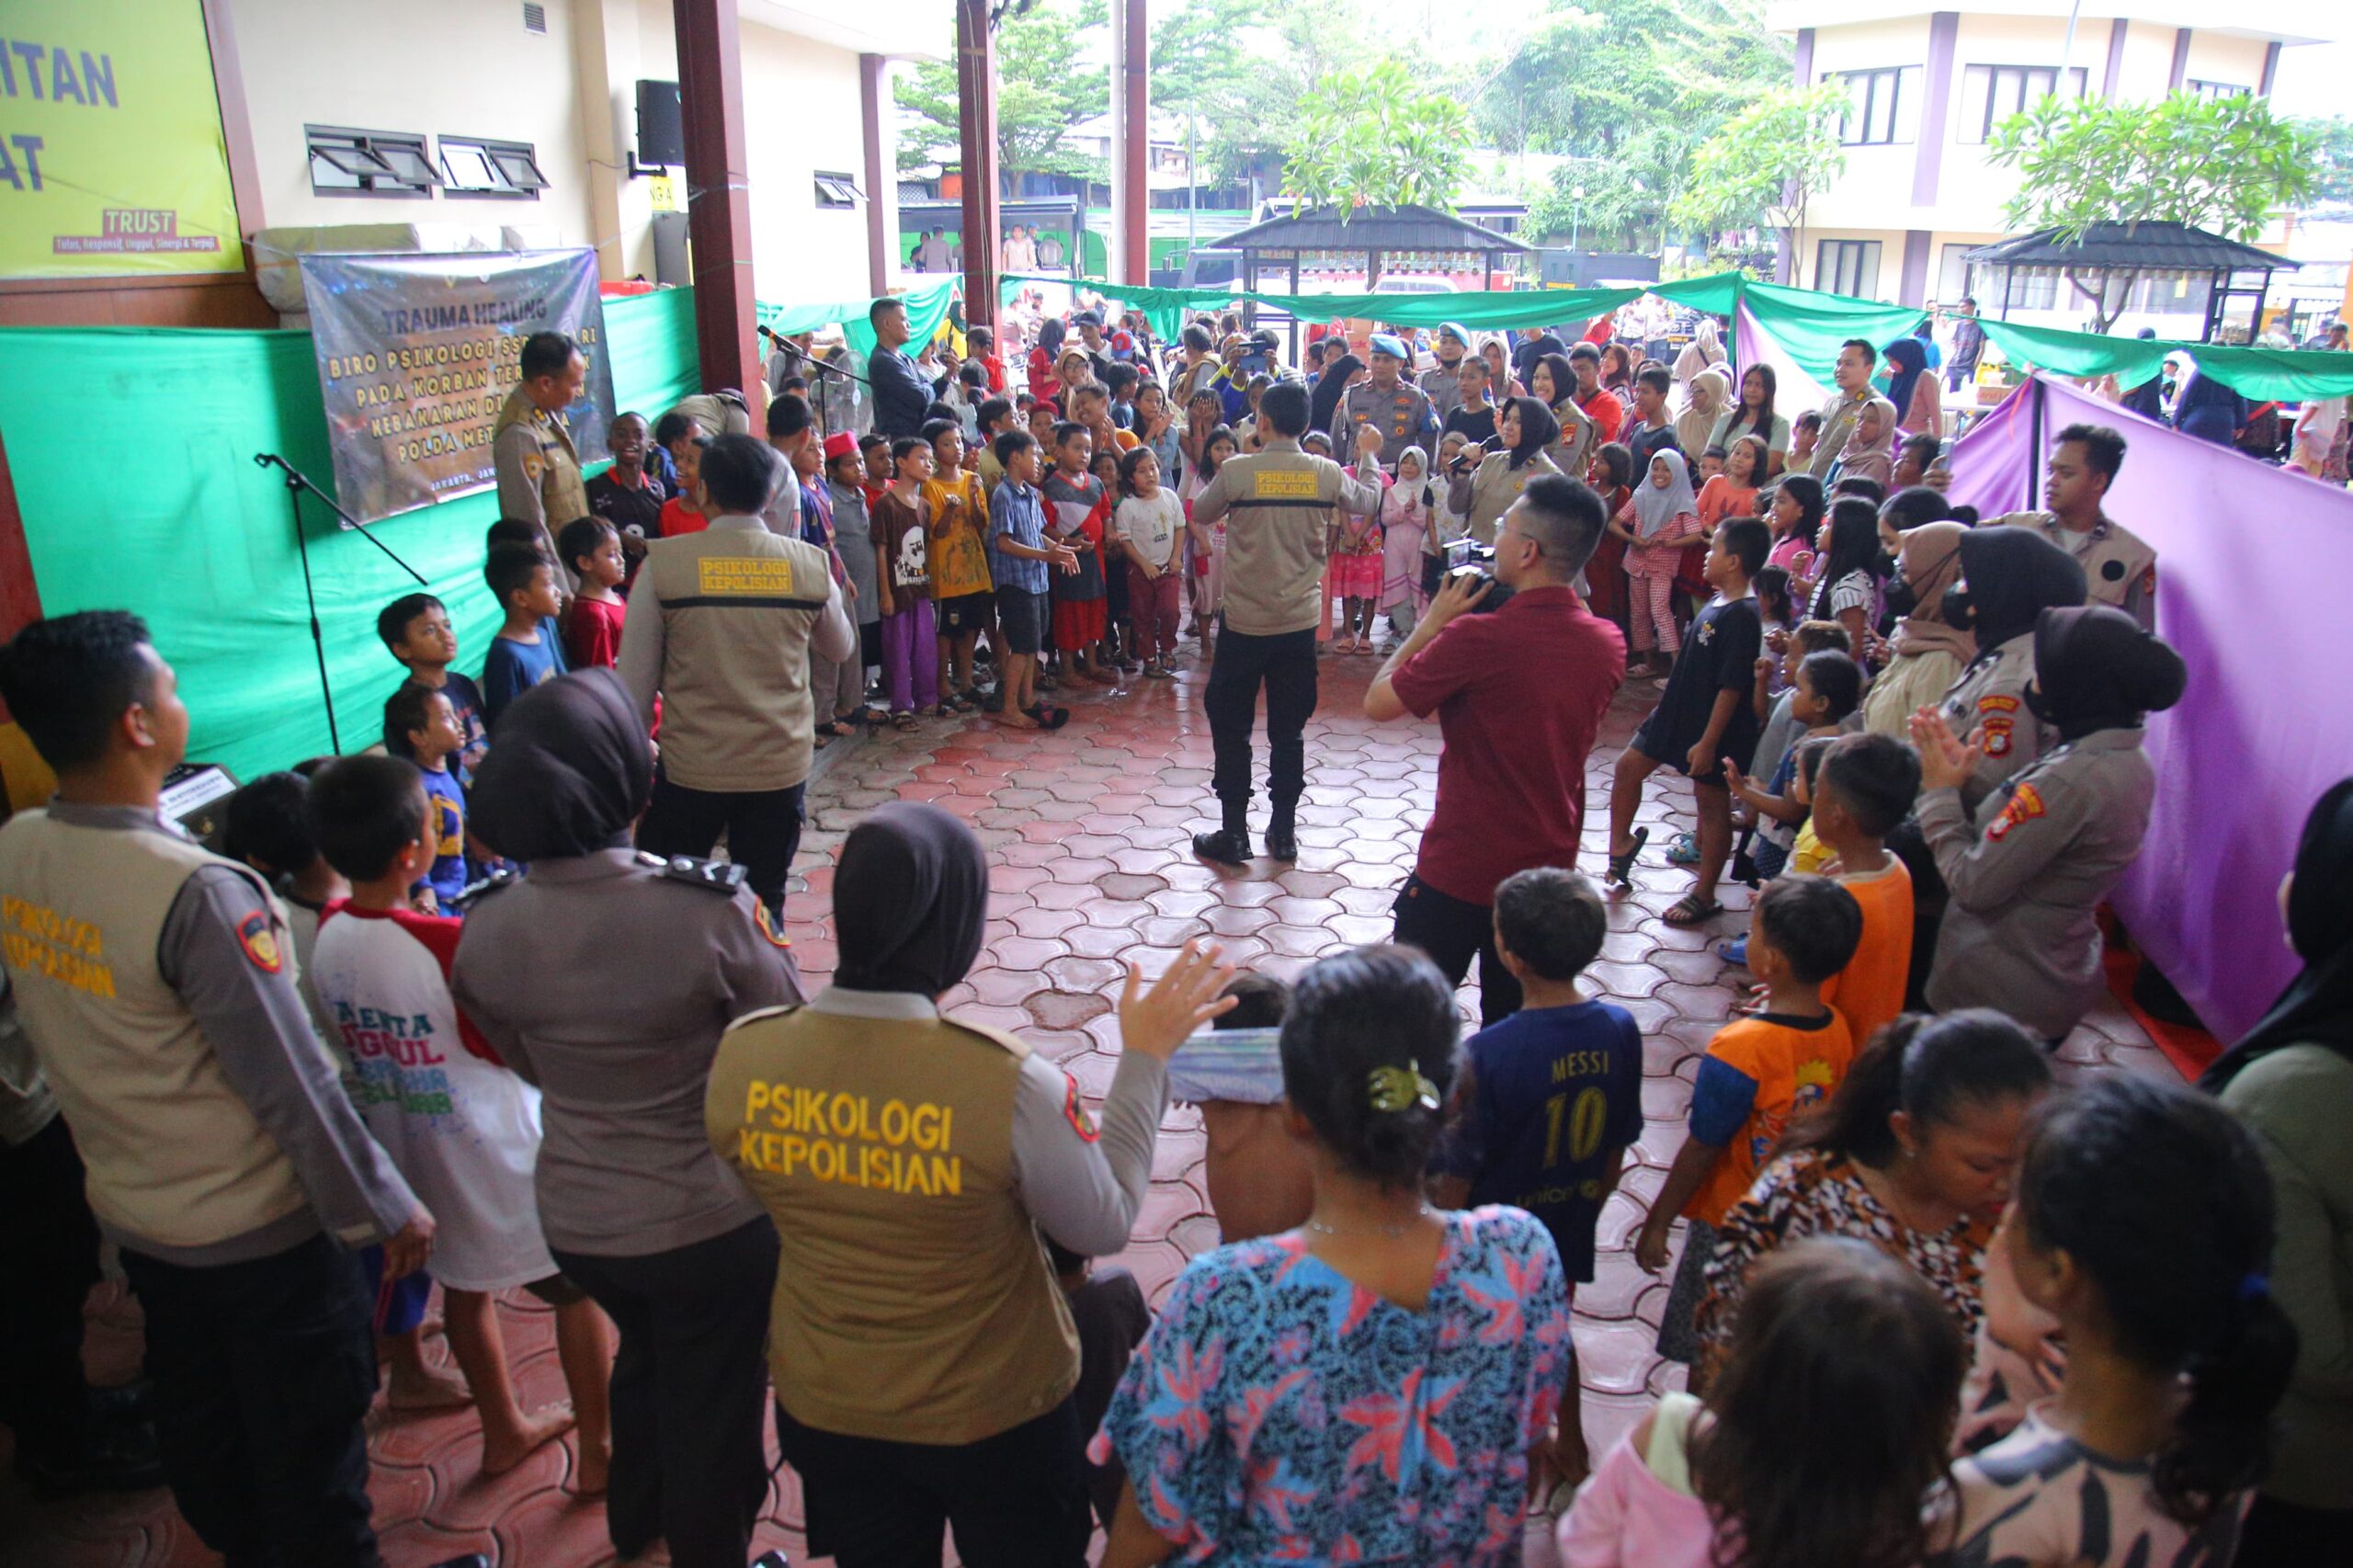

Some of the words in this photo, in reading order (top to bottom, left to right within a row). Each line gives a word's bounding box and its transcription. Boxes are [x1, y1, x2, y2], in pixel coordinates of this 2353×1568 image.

[106, 210, 173, 233] TRUST
[57, 238, 82, 251] Tulus,
[83, 237, 124, 252] Responsif,
[126, 238, 155, 252] Unggul,
[156, 237, 182, 251] Sinergi
[184, 238, 189, 249] &
[381, 304, 472, 335] TRAUMA
[474, 298, 548, 324] HEALING
[329, 353, 378, 379] BIRO
[386, 337, 494, 371] PSIKOLOGI
[356, 386, 405, 408] PADA
[415, 371, 488, 398] KORBAN
[371, 401, 478, 438] KEBAKARAN
[398, 438, 457, 464] POLDA
[463, 428, 495, 449] MET
[430, 473, 474, 492] JAKARTA,
[478, 467, 496, 479] JAN
[1257, 473, 1316, 483] PSIKOLOGI
[1257, 483, 1316, 494] KEPOLISIAN
[702, 561, 789, 574] PSIKOLOGI
[703, 575, 789, 590] KEPOLISIAN
[1552, 1051, 1609, 1085] MESSI
[745, 1080, 952, 1153] PSIKOLOGI
[1542, 1086, 1608, 1168] 10
[739, 1129, 961, 1196] KEPOLISIAN
